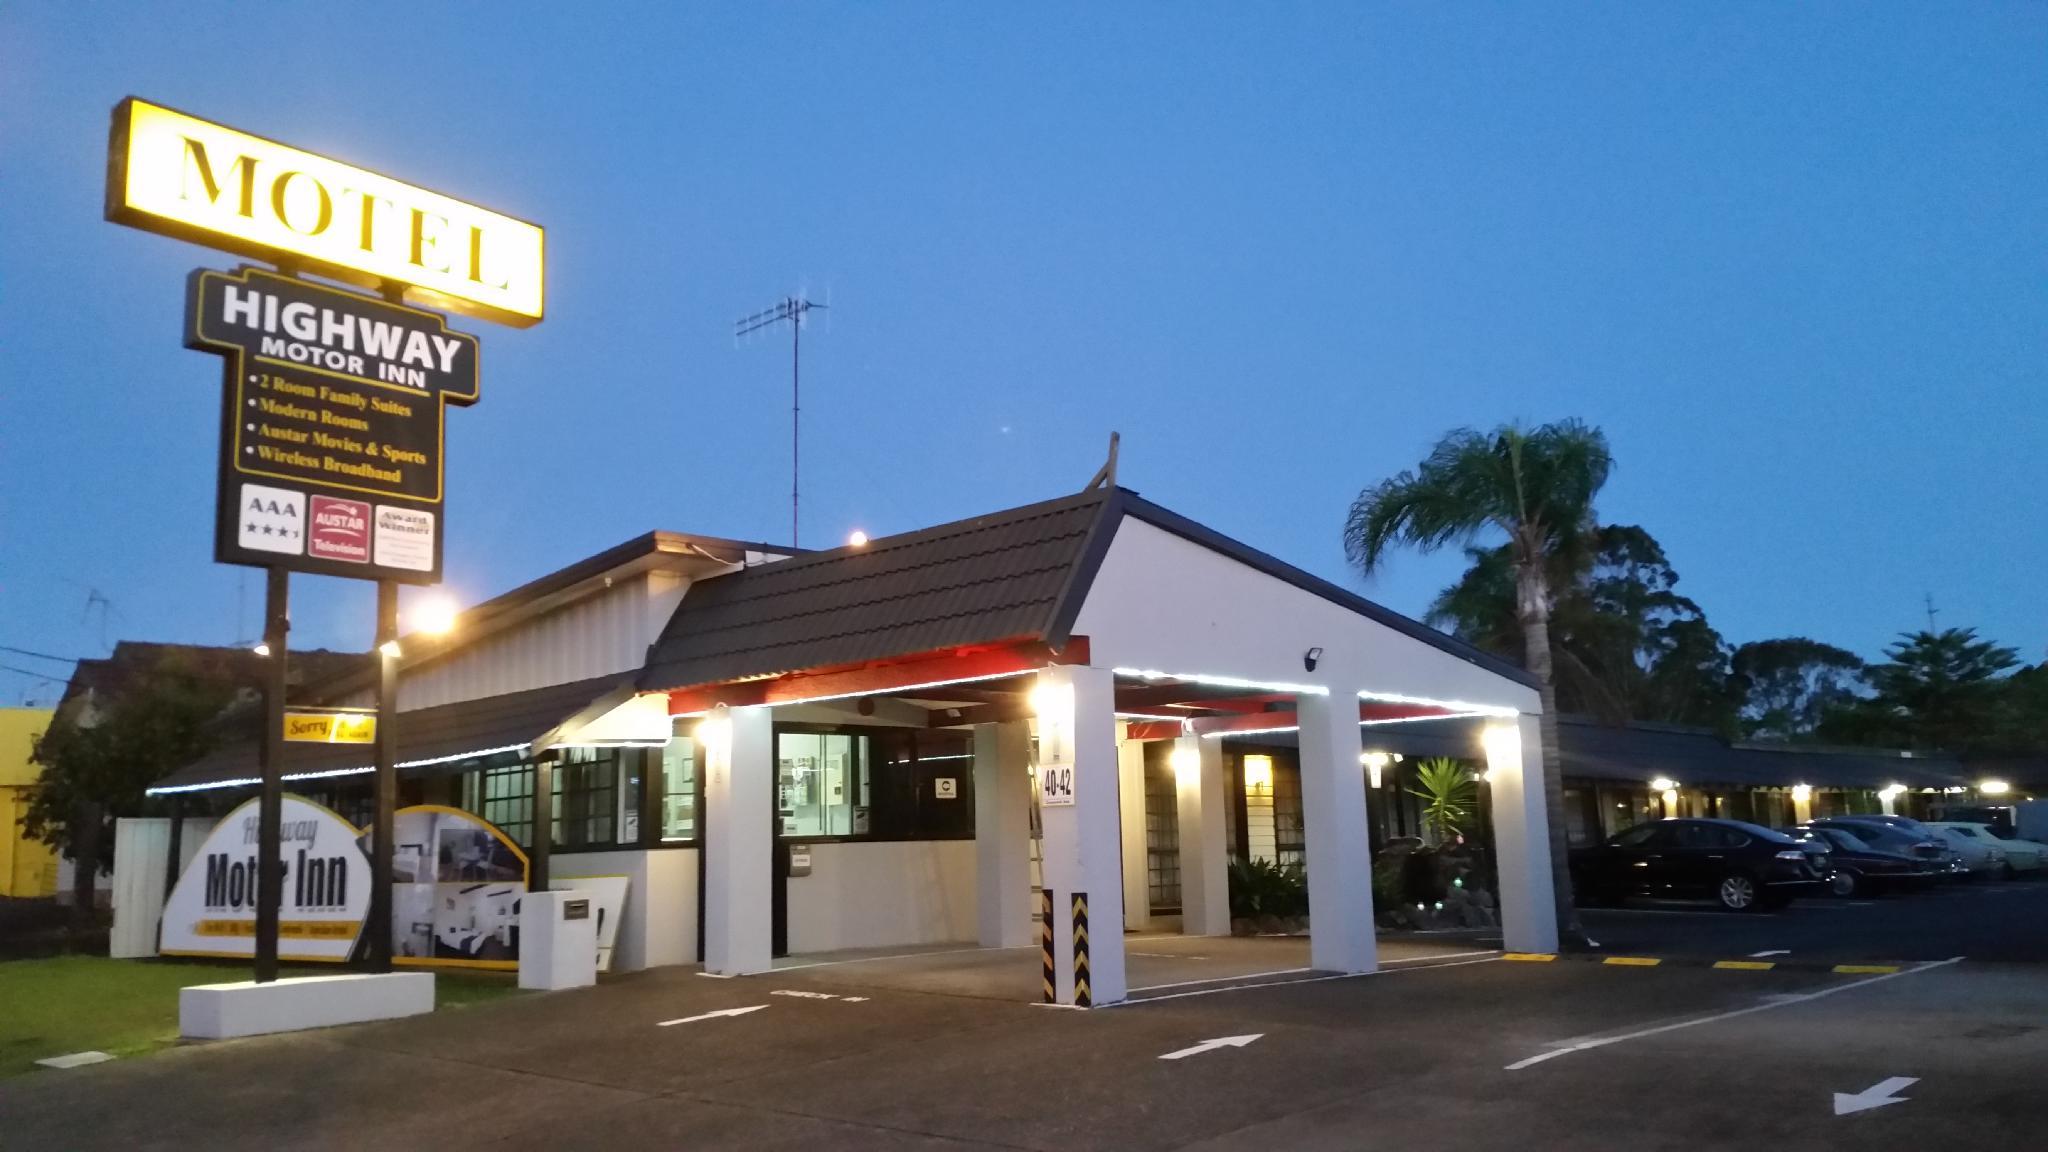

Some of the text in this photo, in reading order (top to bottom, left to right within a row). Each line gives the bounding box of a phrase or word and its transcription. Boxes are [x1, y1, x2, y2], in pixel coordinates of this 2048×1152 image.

[179, 134, 508, 290] MOTEL
[223, 285, 462, 373] HIGHWAY
[261, 336, 427, 388] MOTOR INN
[259, 397, 369, 432] Modern Rooms
[260, 374, 412, 417] 2 Room Family Suites
[257, 445, 402, 483] Wireless Broadband
[258, 423, 427, 465] Austar Movies & Sports
[249, 497, 297, 518] AAA
[315, 512, 365, 530] AUSTAR
[296, 848, 347, 908] Inn
